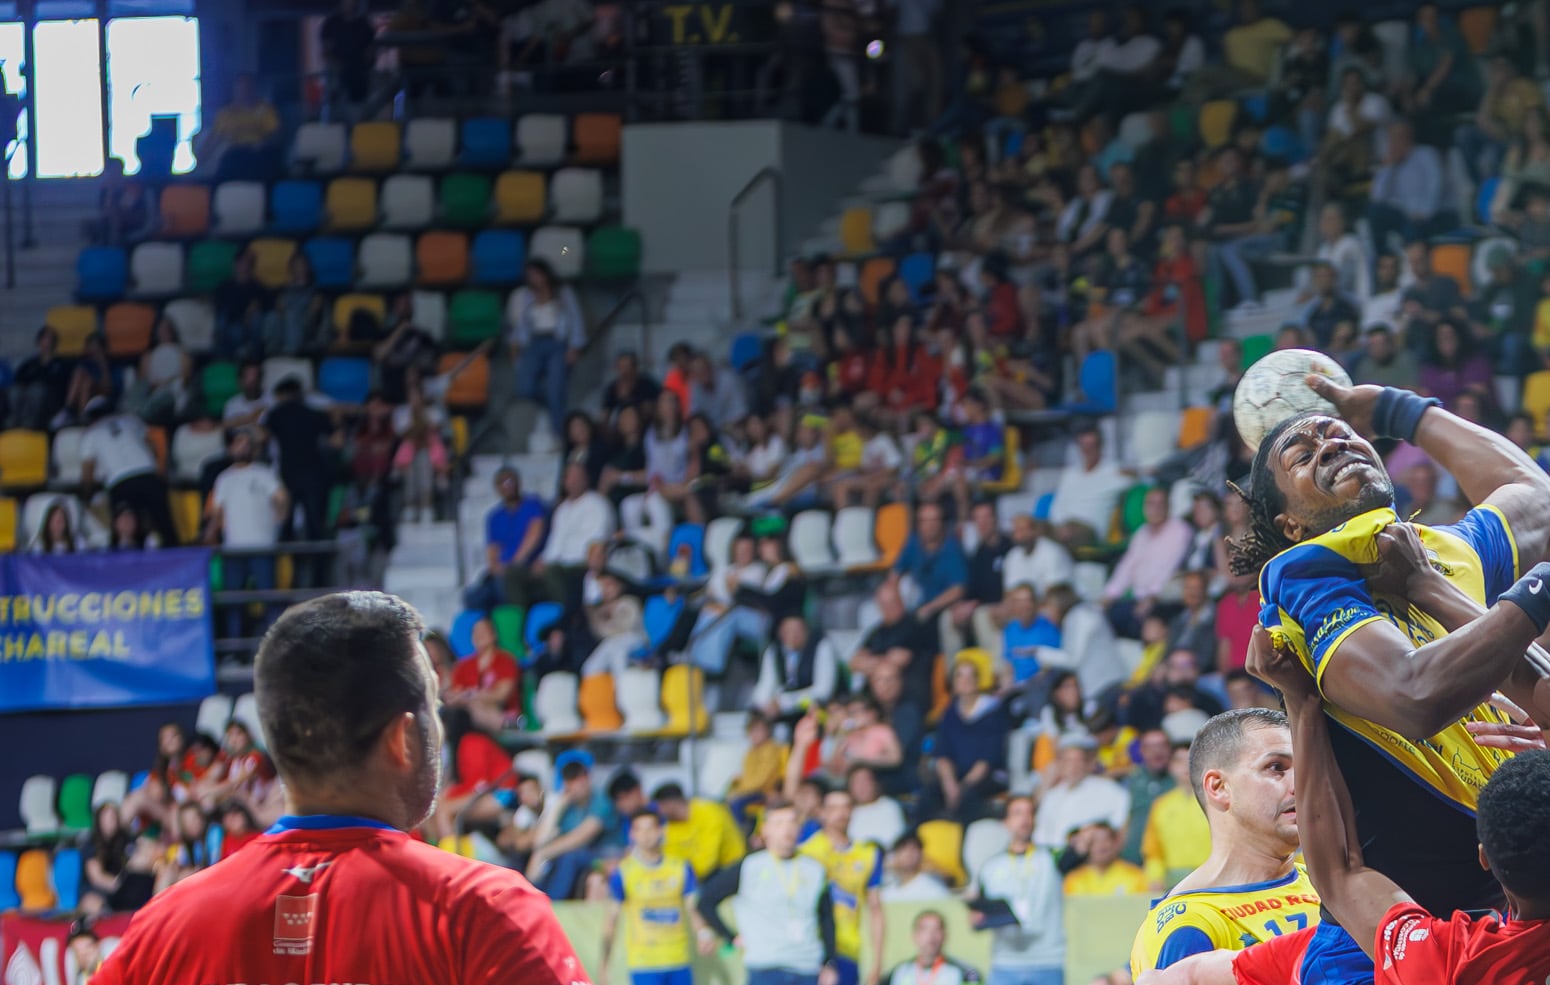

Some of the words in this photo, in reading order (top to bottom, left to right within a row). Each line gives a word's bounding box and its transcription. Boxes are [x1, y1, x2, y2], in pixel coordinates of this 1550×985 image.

[662, 3, 739, 44] T.V.
[0, 629, 130, 664] HAREAL
[1220, 897, 1283, 921] CIUDAD
